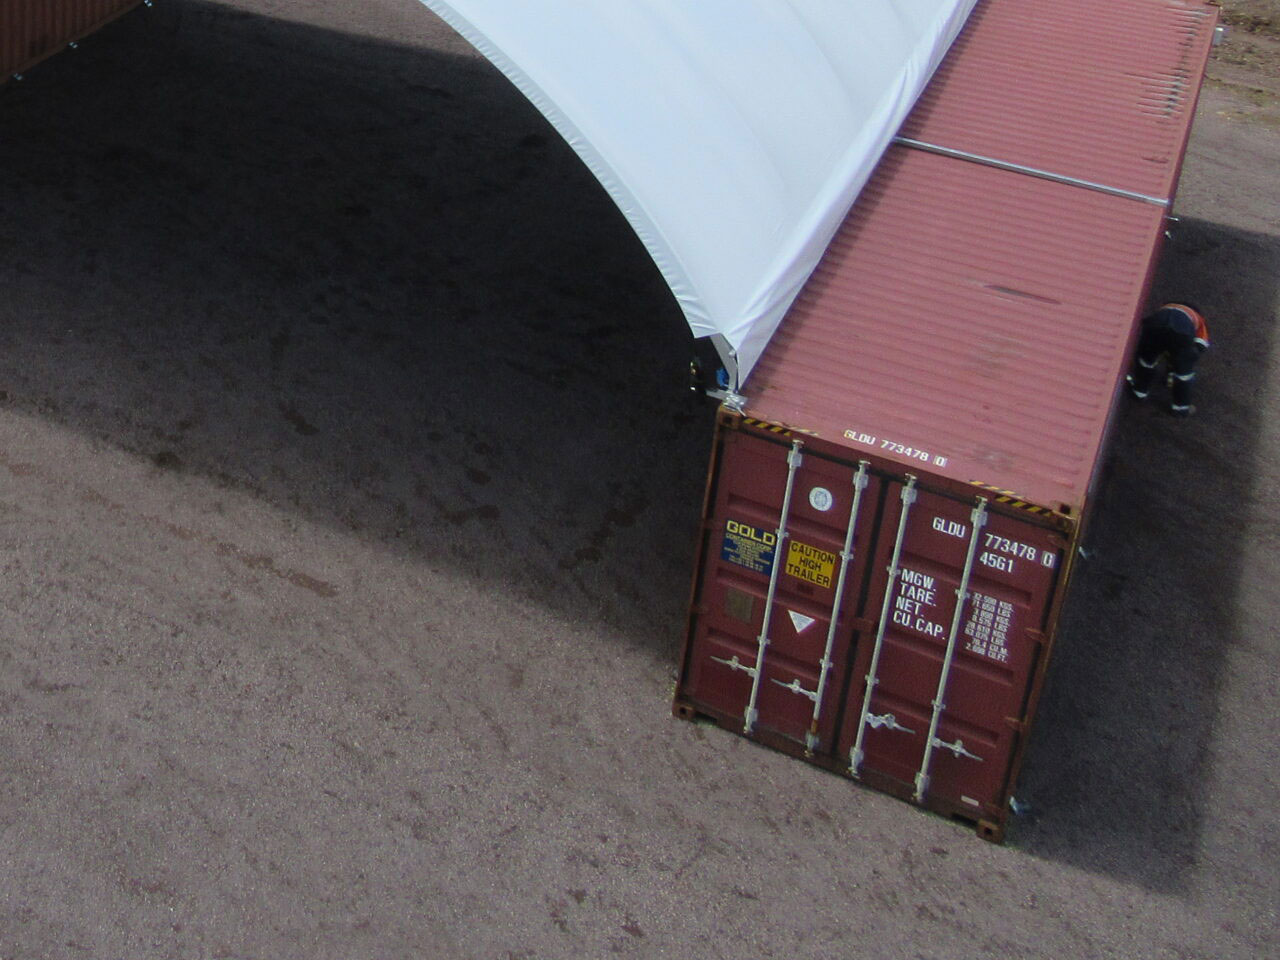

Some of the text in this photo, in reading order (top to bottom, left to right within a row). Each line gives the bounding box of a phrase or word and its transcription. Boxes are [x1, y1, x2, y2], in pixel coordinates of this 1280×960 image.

[844, 429, 876, 445] GLDU
[880, 440, 929, 462] 773478
[726, 520, 776, 546] GOLD
[932, 517, 966, 538] GLDU
[984, 533, 1037, 561] 773478
[791, 543, 834, 564] CAUTION
[799, 556, 821, 571] HIGH
[980, 552, 1014, 573] 45G1
[788, 564, 830, 586] TRAILER
[901, 568, 936, 591] MGW.
[900, 582, 936, 607] TARE.
[896, 596, 924, 617] NET.
[893, 610, 945, 640] CU.CAP.
